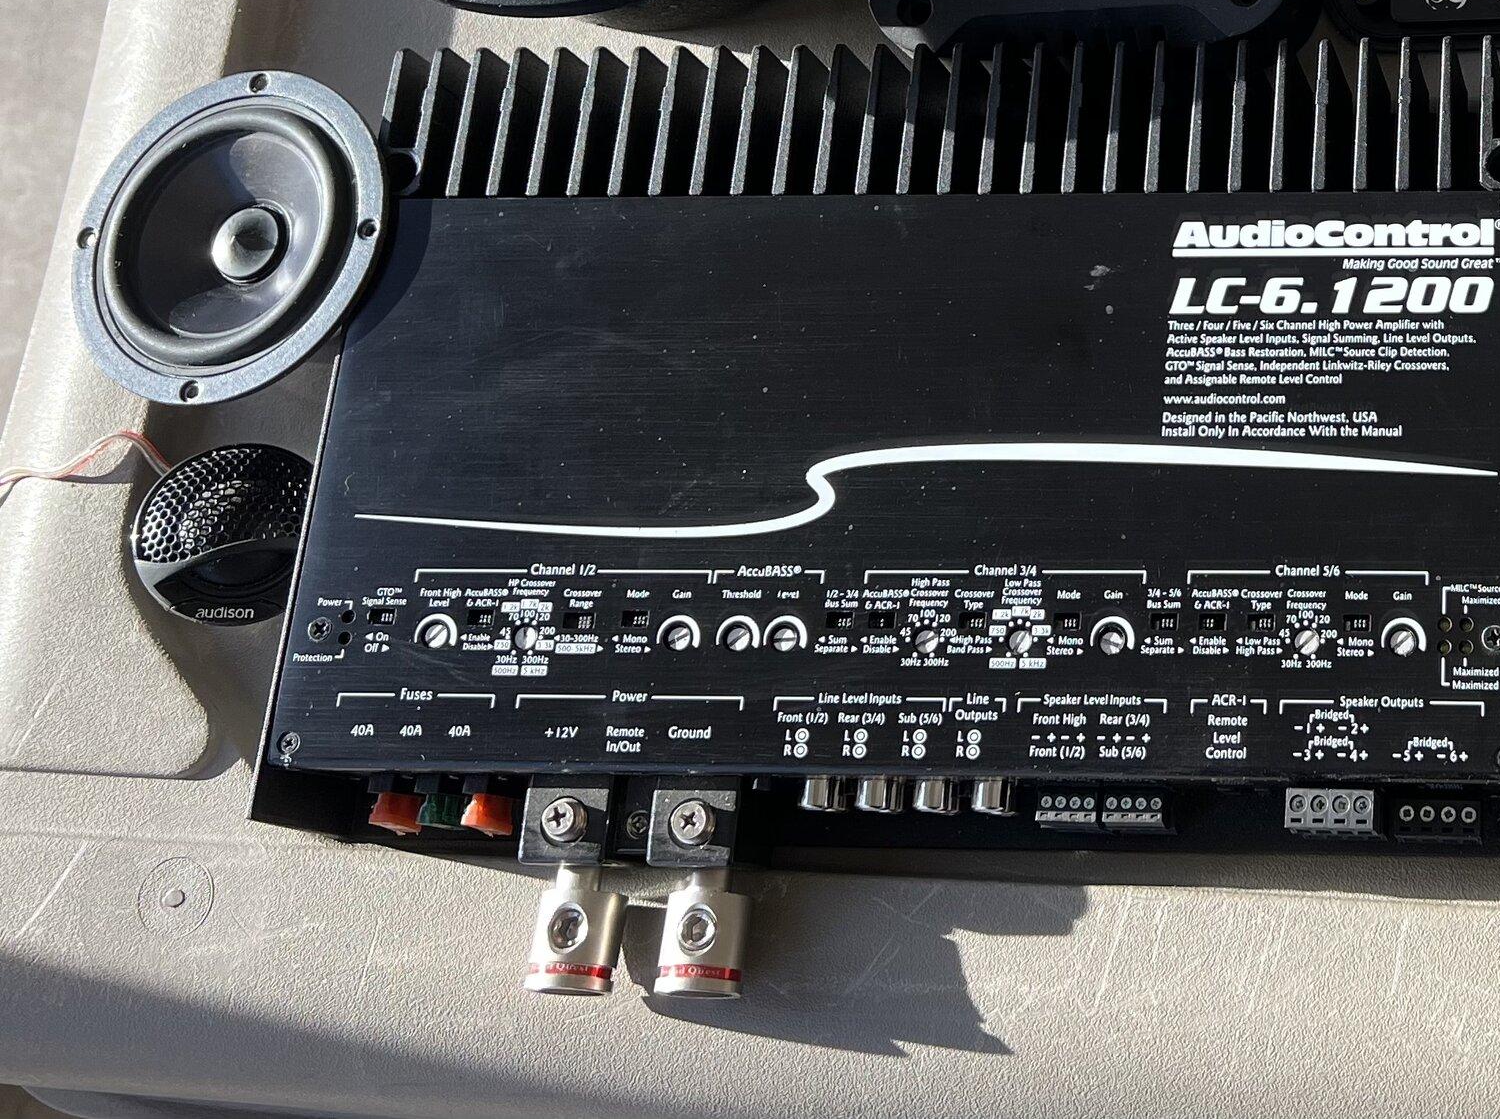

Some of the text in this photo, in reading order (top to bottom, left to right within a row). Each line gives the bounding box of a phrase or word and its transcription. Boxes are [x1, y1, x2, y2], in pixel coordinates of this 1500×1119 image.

[1342, 258, 1385, 270] Making
[1388, 258, 1418, 270] Good
[1421, 258, 1459, 270] Sound
[1168, 320, 1444, 332] Three Four Five Six Channel High Power Amplifier with
[1167, 334, 1198, 344] Active
[1200, 334, 1237, 346] Speaker
[1239, 334, 1263, 343] Level
[1302, 334, 1330, 346] Signal
[1383, 334, 1403, 343] Line
[1406, 334, 1429, 343] Level
[1224, 347, 1246, 357] Bass
[1344, 347, 1375, 357] Source
[1378, 347, 1397, 359] Clip
[1196, 361, 1224, 373] Signal
[1260, 360, 1320, 372] Independent
[1323, 360, 1391, 373] Linkwitz-Riley
[1164, 374, 1342, 386] and Assignable Remote Level Control
[1164, 393, 1286, 404] www.audiocontrol.com
[1162, 412, 1212, 425] Designed
[1215, 412, 1225, 422] in
[1228, 412, 1247, 422] the
[1250, 411, 1285, 422] Pacific
[1353, 412, 1377, 422] USA
[1161, 425, 1195, 437] Install
[1198, 425, 1226, 439] Only
[1241, 425, 1306, 436] Accordance
[1308, 425, 1336, 436] With
[1340, 425, 1357, 436] the
[1360, 425, 1402, 436] Manual
[531, 564, 576, 576] Channel
[974, 564, 1037, 576] Channel 3/4
[1275, 565, 1340, 577] Channel 5/6
[317, 598, 342, 606] Power
[196, 607, 254, 619] audison
[293, 653, 332, 661] Protection
[1453, 667, 1499, 676] Maximized
[1452, 680, 1499, 690] Maximized
[400, 688, 433, 700] Fuses
[612, 690, 648, 702] Power
[818, 693, 902, 706] Line Level Inputs
[967, 693, 989, 704] Line
[1043, 694, 1141, 707] Speaker Level Inputs
[1340, 696, 1424, 709] Speaker Outputs
[778, 711, 802, 723] Front
[838, 712, 885, 726] Rear (3/4)
[898, 712, 942, 726] Sub (5/6)
[955, 709, 998, 722] Outputs
[1033, 713, 1086, 726] Front High
[1100, 713, 1150, 727] Rear (3/4)
[1207, 714, 1248, 726] Remote
[1315, 710, 1349, 720] Bridged
[351, 724, 374, 736] 40A
[400, 724, 422, 736] 40A
[448, 724, 471, 736] 40A
[544, 726, 578, 739] +12V
[606, 726, 645, 738] Remote
[668, 726, 712, 739] Ground
[1213, 732, 1240, 743] Level
[1314, 736, 1349, 747] Bridged
[1413, 737, 1448, 748] Bridged
[606, 741, 641, 753] In/Out
[1029, 746, 1057, 757] Front
[1099, 746, 1146, 760] Sub (5/6)
[1205, 747, 1247, 759] Control
